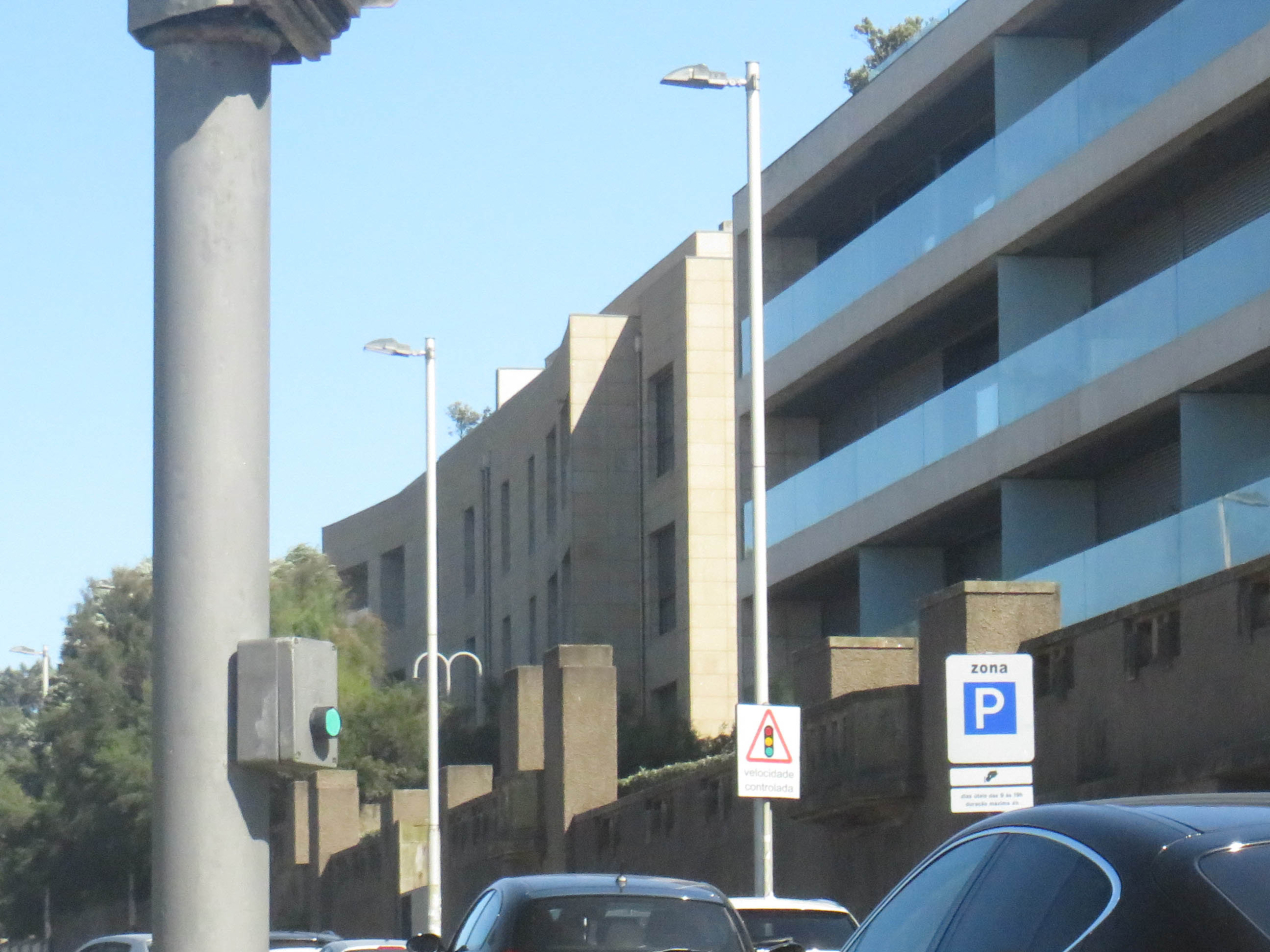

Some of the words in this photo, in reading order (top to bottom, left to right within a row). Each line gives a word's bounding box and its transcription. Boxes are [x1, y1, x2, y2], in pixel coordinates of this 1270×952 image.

[971, 663, 1008, 674] zona
[975, 687, 1005, 730] P
[744, 768, 794, 779] velocidade
[744, 783, 794, 793] controlada
